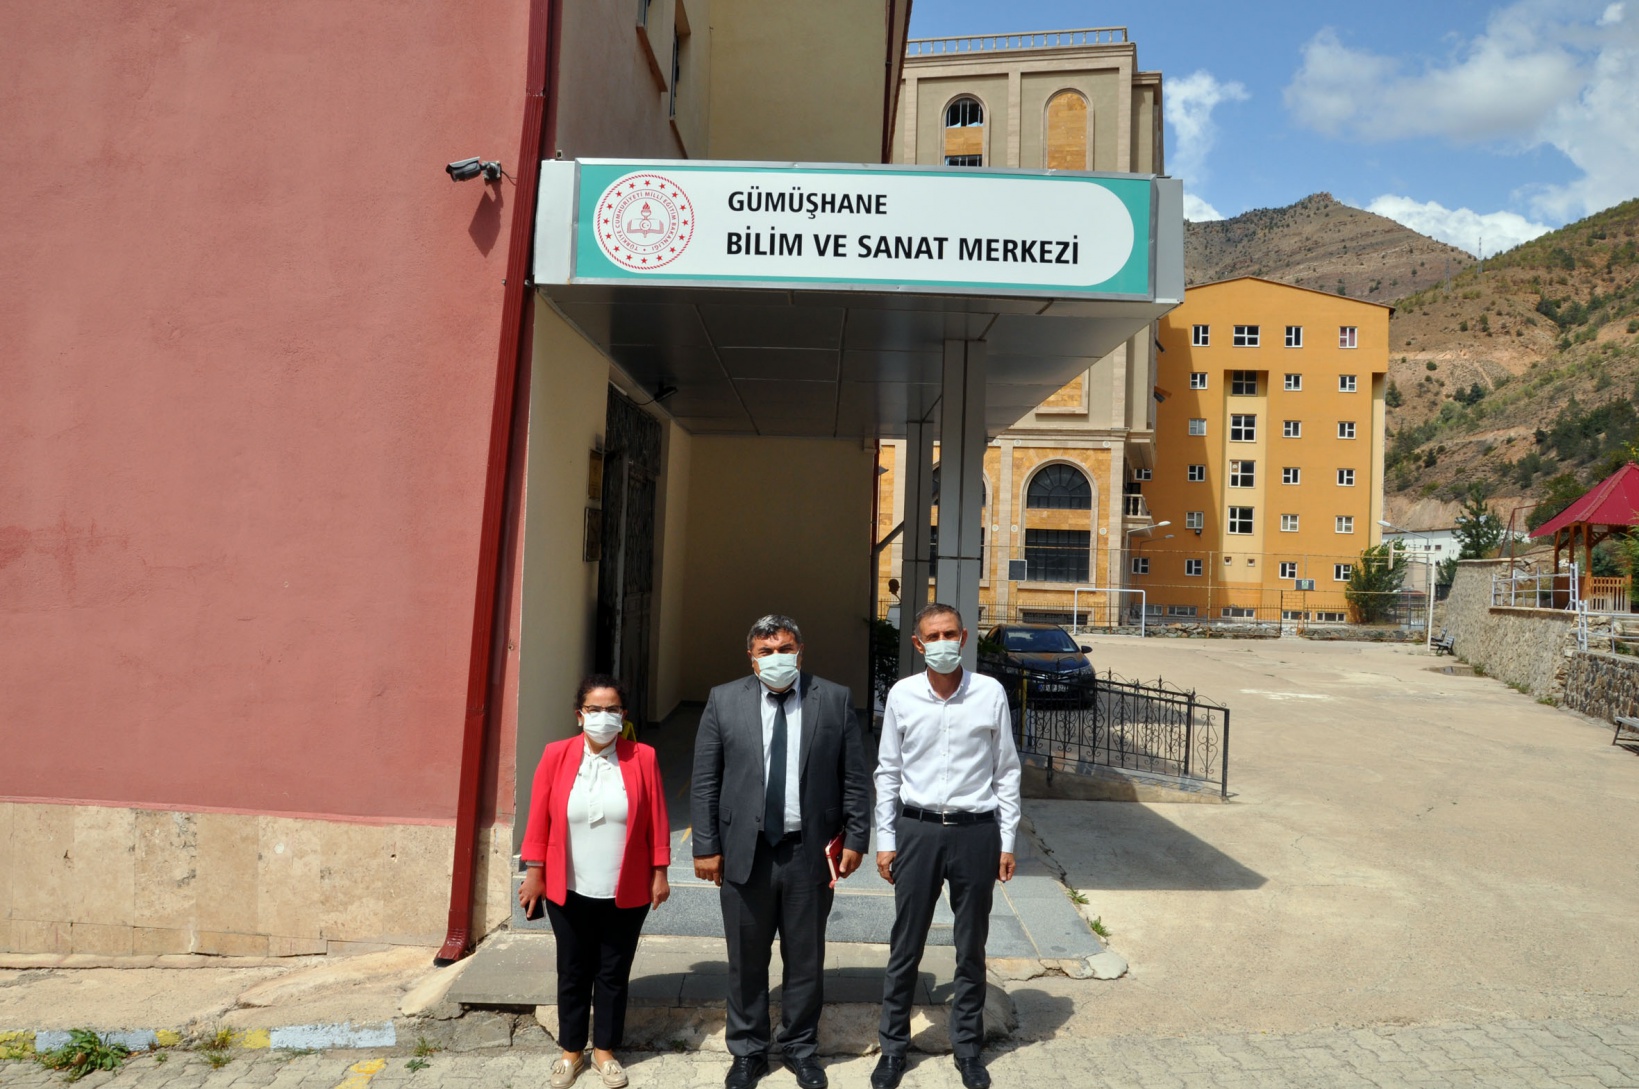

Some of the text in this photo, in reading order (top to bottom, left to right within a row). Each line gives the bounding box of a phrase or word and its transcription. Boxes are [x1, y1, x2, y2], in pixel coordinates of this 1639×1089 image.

[615, 191, 643, 229] CUMHURİYETİ
[644, 191, 663, 201] MİLLİ
[728, 186, 888, 220] GÜMÜŞHANE
[616, 230, 639, 251] TÜRKİYE
[651, 222, 677, 251] BAKANLIĞI
[727, 226, 1079, 265] BİLİM VE SANAT MERKEZİ
